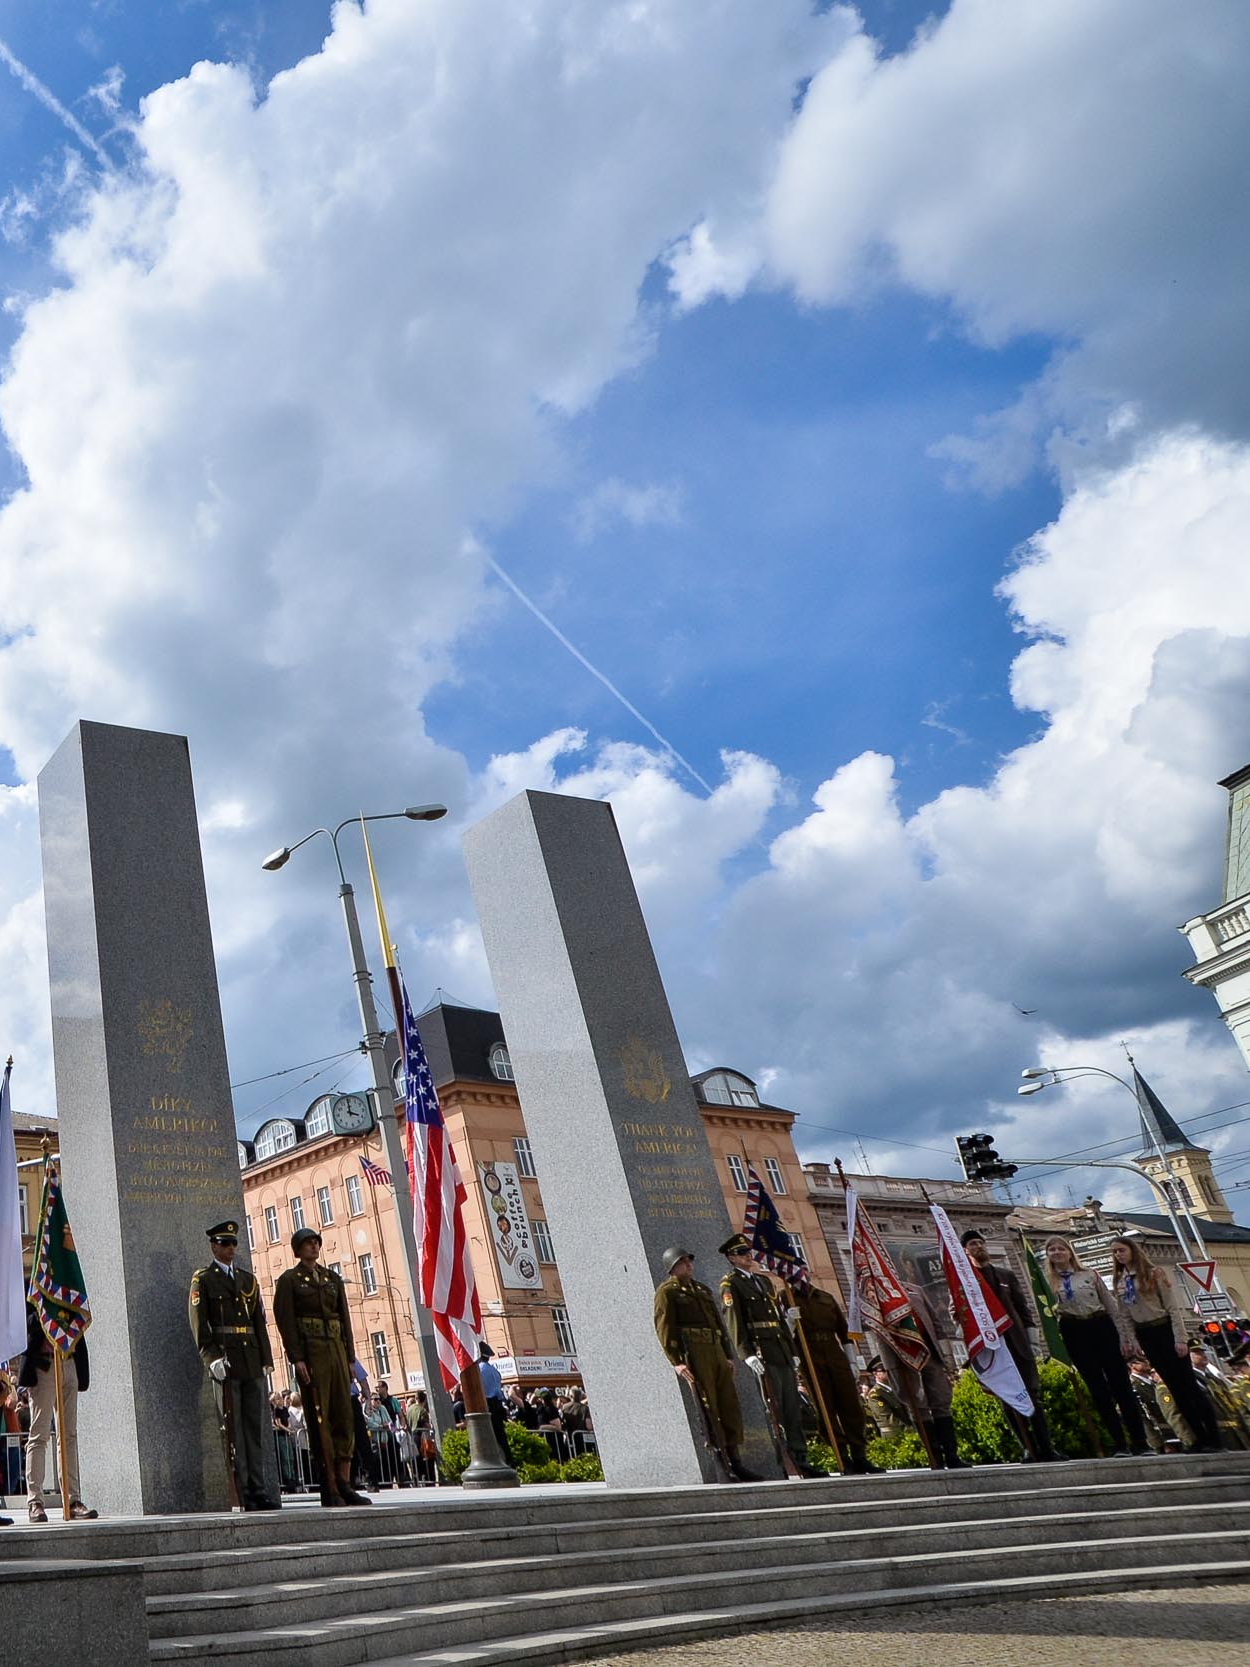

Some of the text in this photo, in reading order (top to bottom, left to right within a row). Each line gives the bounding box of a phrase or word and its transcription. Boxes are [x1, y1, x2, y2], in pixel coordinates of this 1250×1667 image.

[622, 1122, 668, 1138] THANK
[507, 1192, 522, 1239] coffee
[512, 1189, 529, 1239] brunch
